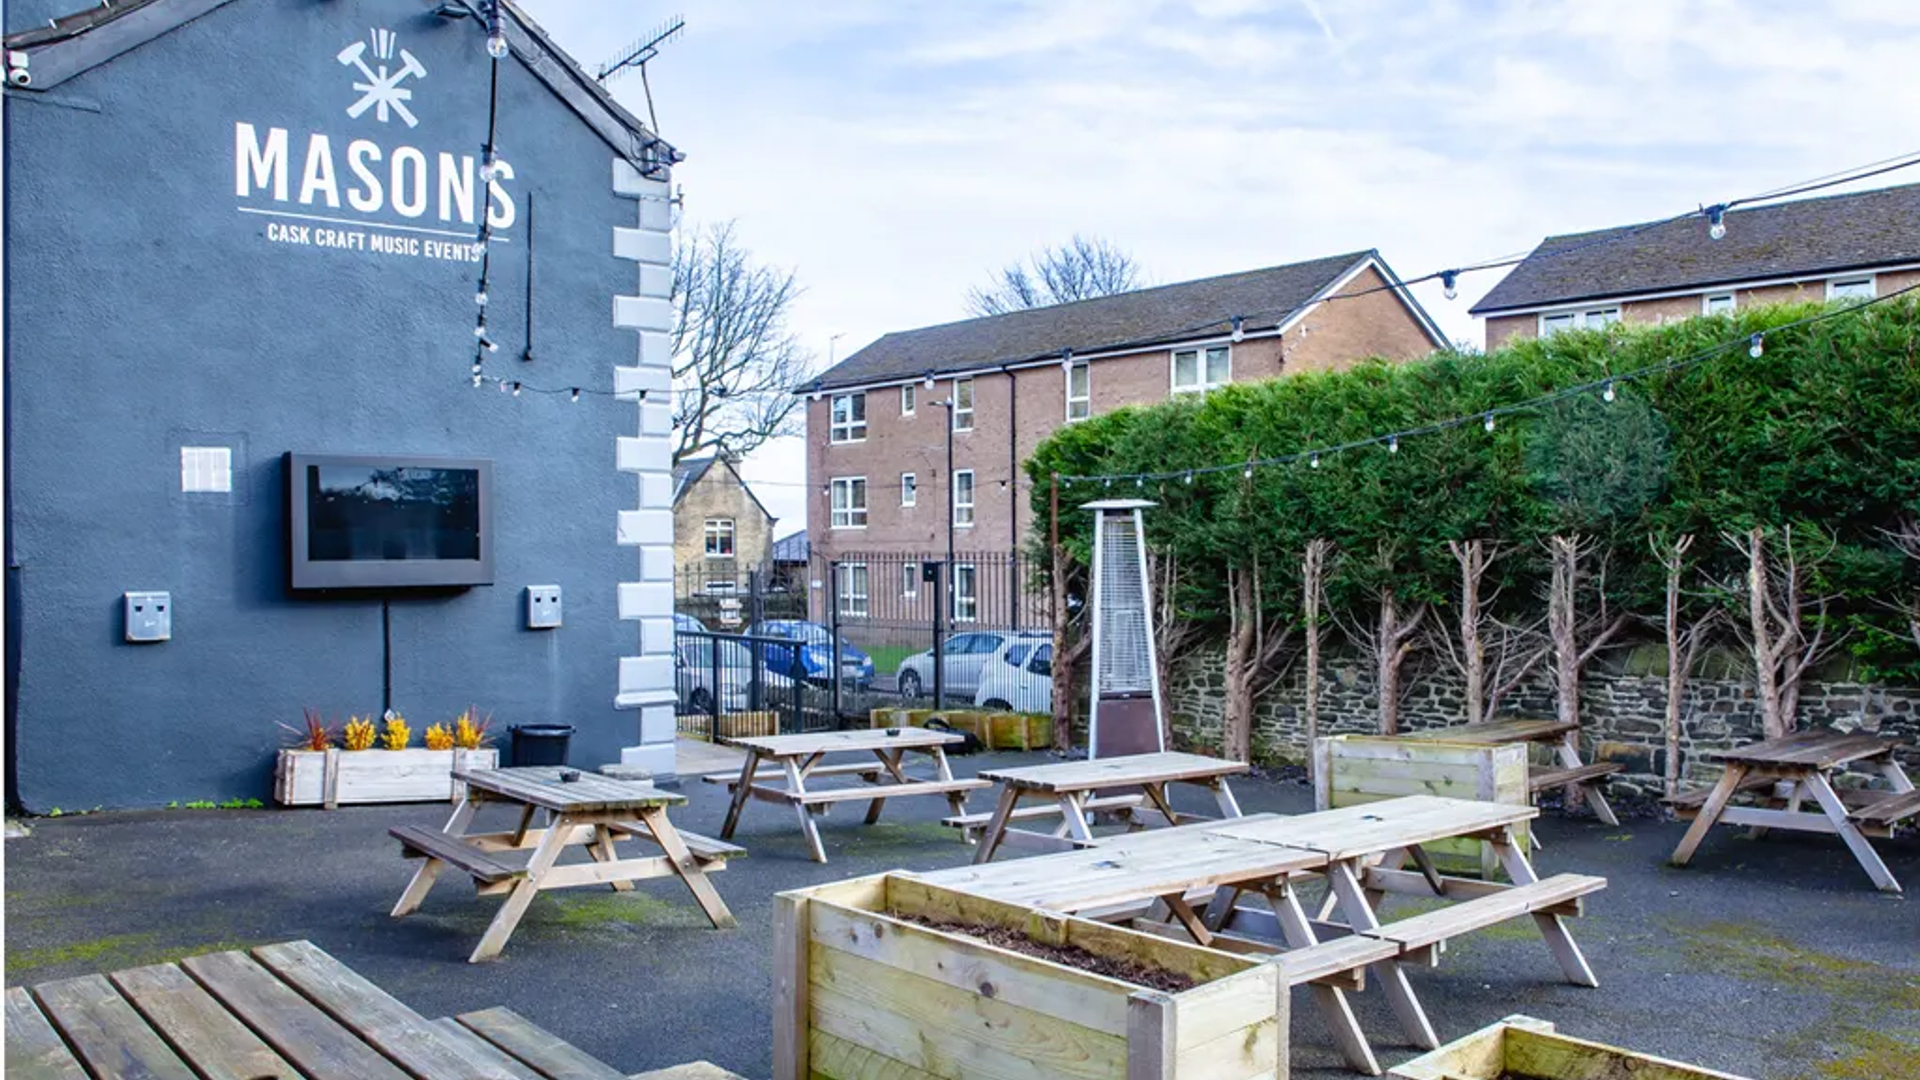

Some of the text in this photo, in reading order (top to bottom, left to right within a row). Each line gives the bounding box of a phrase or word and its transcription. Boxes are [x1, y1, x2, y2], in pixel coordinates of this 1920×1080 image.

[235, 121, 516, 229] MASONS
[267, 222, 481, 263] CASK CRAFT MUSIC EVENTS
